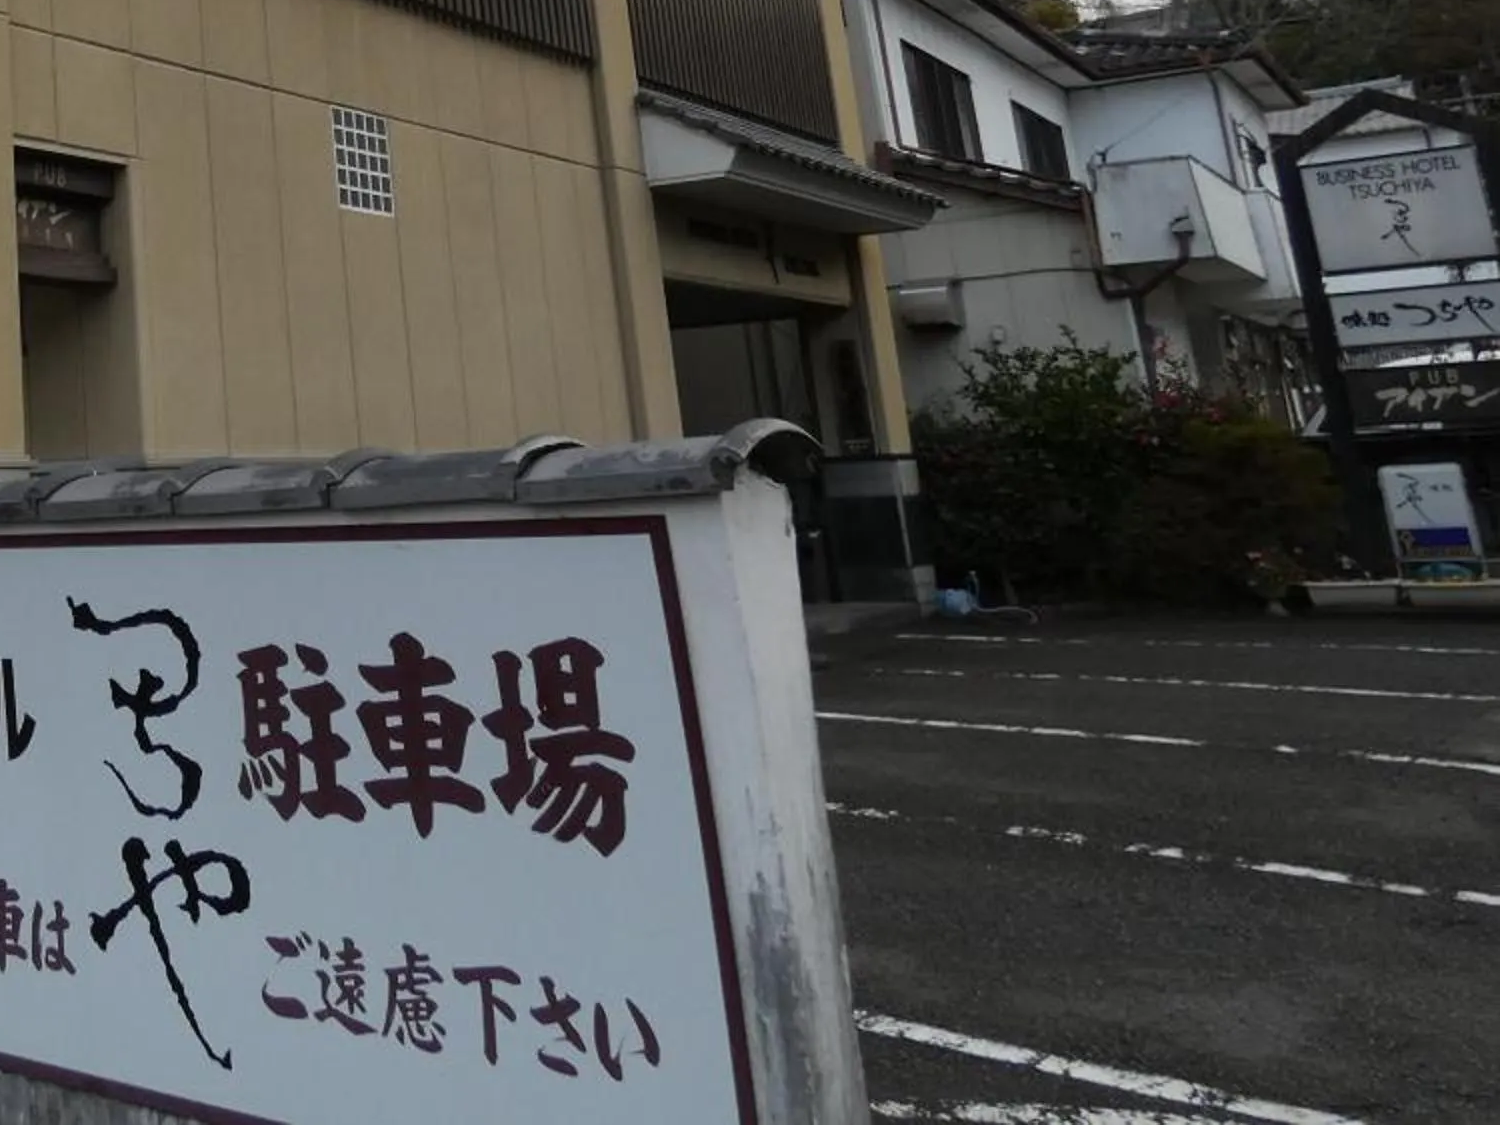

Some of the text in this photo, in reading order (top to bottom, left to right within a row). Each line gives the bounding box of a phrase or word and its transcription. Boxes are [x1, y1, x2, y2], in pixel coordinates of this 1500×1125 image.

[33, 162, 66, 187] PUB
[1315, 155, 1461, 186] BUSINESS HOTEL
[1349, 178, 1435, 200] TSUCHIYA
[1409, 369, 1459, 386] PUB
[66, 596, 251, 1070] つちや
[237, 632, 636, 857] 駐車場
[262, 932, 660, 1081] ご遠慮下さい
